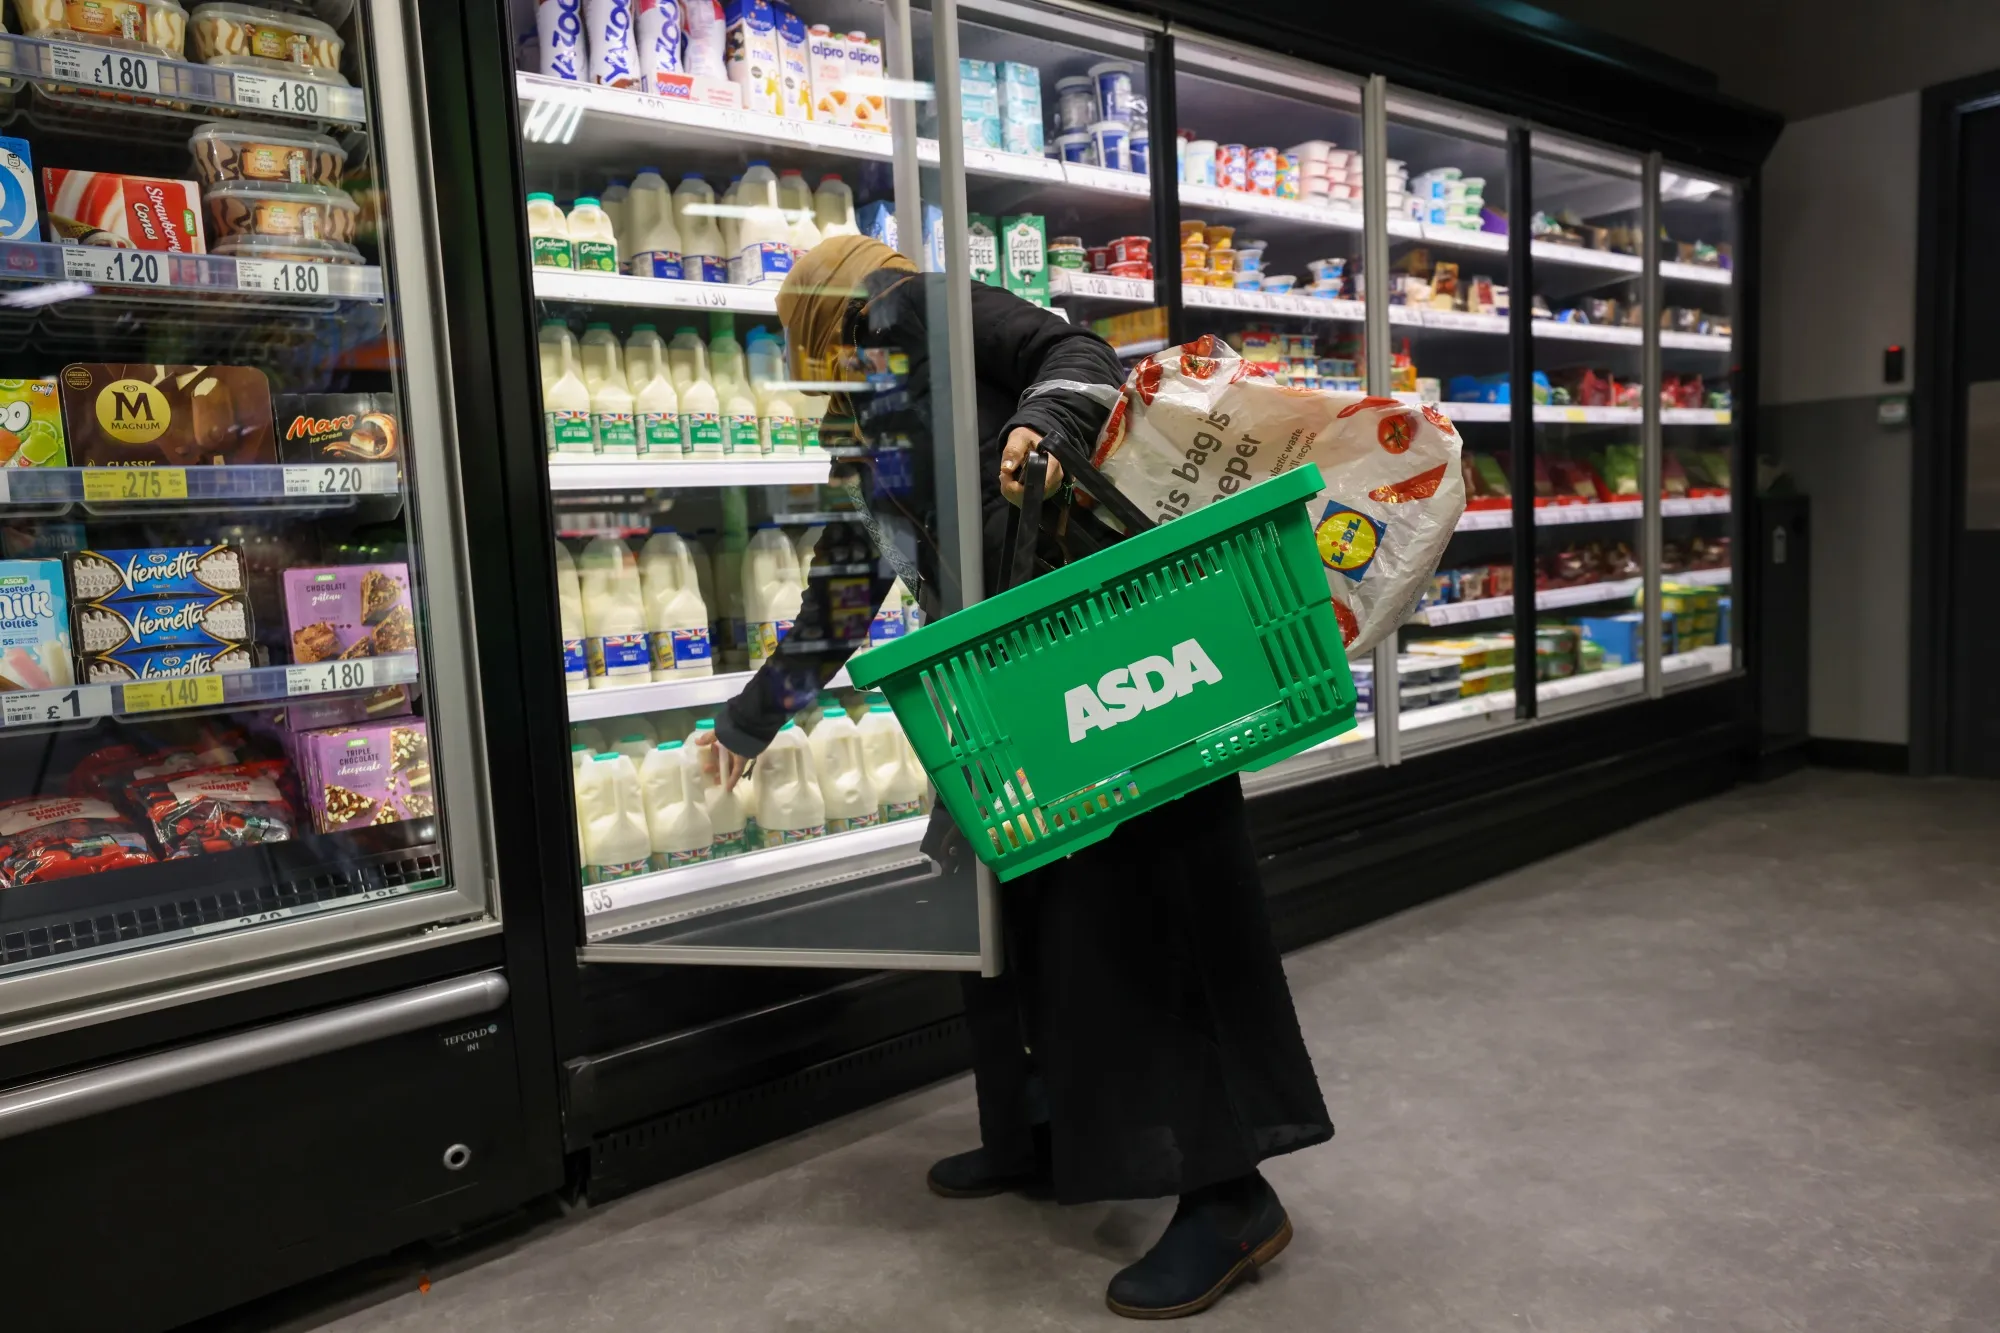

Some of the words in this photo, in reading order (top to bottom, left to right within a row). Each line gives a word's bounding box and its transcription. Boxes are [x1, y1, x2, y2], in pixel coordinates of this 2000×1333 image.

[812, 42, 844, 59] alpro
[848, 48, 880, 65] alpro
[94, 54, 148, 90] £1.80
[272, 81, 318, 114] £1.80
[133, 202, 158, 240] Cones
[185, 213, 195, 233] ASDA
[1011, 237, 1039, 250] Lacto
[106, 252, 159, 284] £1.20
[1012, 250, 1041, 267] FREE
[274, 264, 319, 293] £1.80
[31, 384, 45, 393] 6x
[111, 390, 156, 421] M
[111, 422, 160, 430] MAGNUM
[286, 414, 357, 440] Mars
[1197, 411, 1231, 432] is
[310, 436, 320, 444] Ice
[321, 431, 343, 442] Cream
[1296, 432, 1317, 460] recycle
[1171, 431, 1222, 484] bag
[1269, 453, 1289, 478] lastic
[1284, 428, 1305, 453] waste.
[318, 467, 362, 494] £2.20
[1211, 433, 1262, 503] eper
[122, 471, 162, 498] £2.75
[1156, 489, 1190, 526] is
[112, 550, 199, 592] Viennetta
[0, 584, 35, 594] ssorted
[306, 583, 346, 592] CHOCOLATE
[0, 619, 38, 630] lollies
[119, 602, 205, 644] Viennetta
[126, 652, 212, 680] Viennetta
[320, 662, 364, 690] £1.80
[160, 678, 198, 707] £1.40
[1064, 638, 1223, 744] ASDA
[339, 753, 379, 765] CHOCOLATE
[346, 748, 371, 757] TRIPLE
[337, 761, 383, 776] cheesecake
[28, 802, 82, 817] SUMMER
[36, 807, 81, 821] FRUITS
[444, 1028, 488, 1046] TEFCOLD
